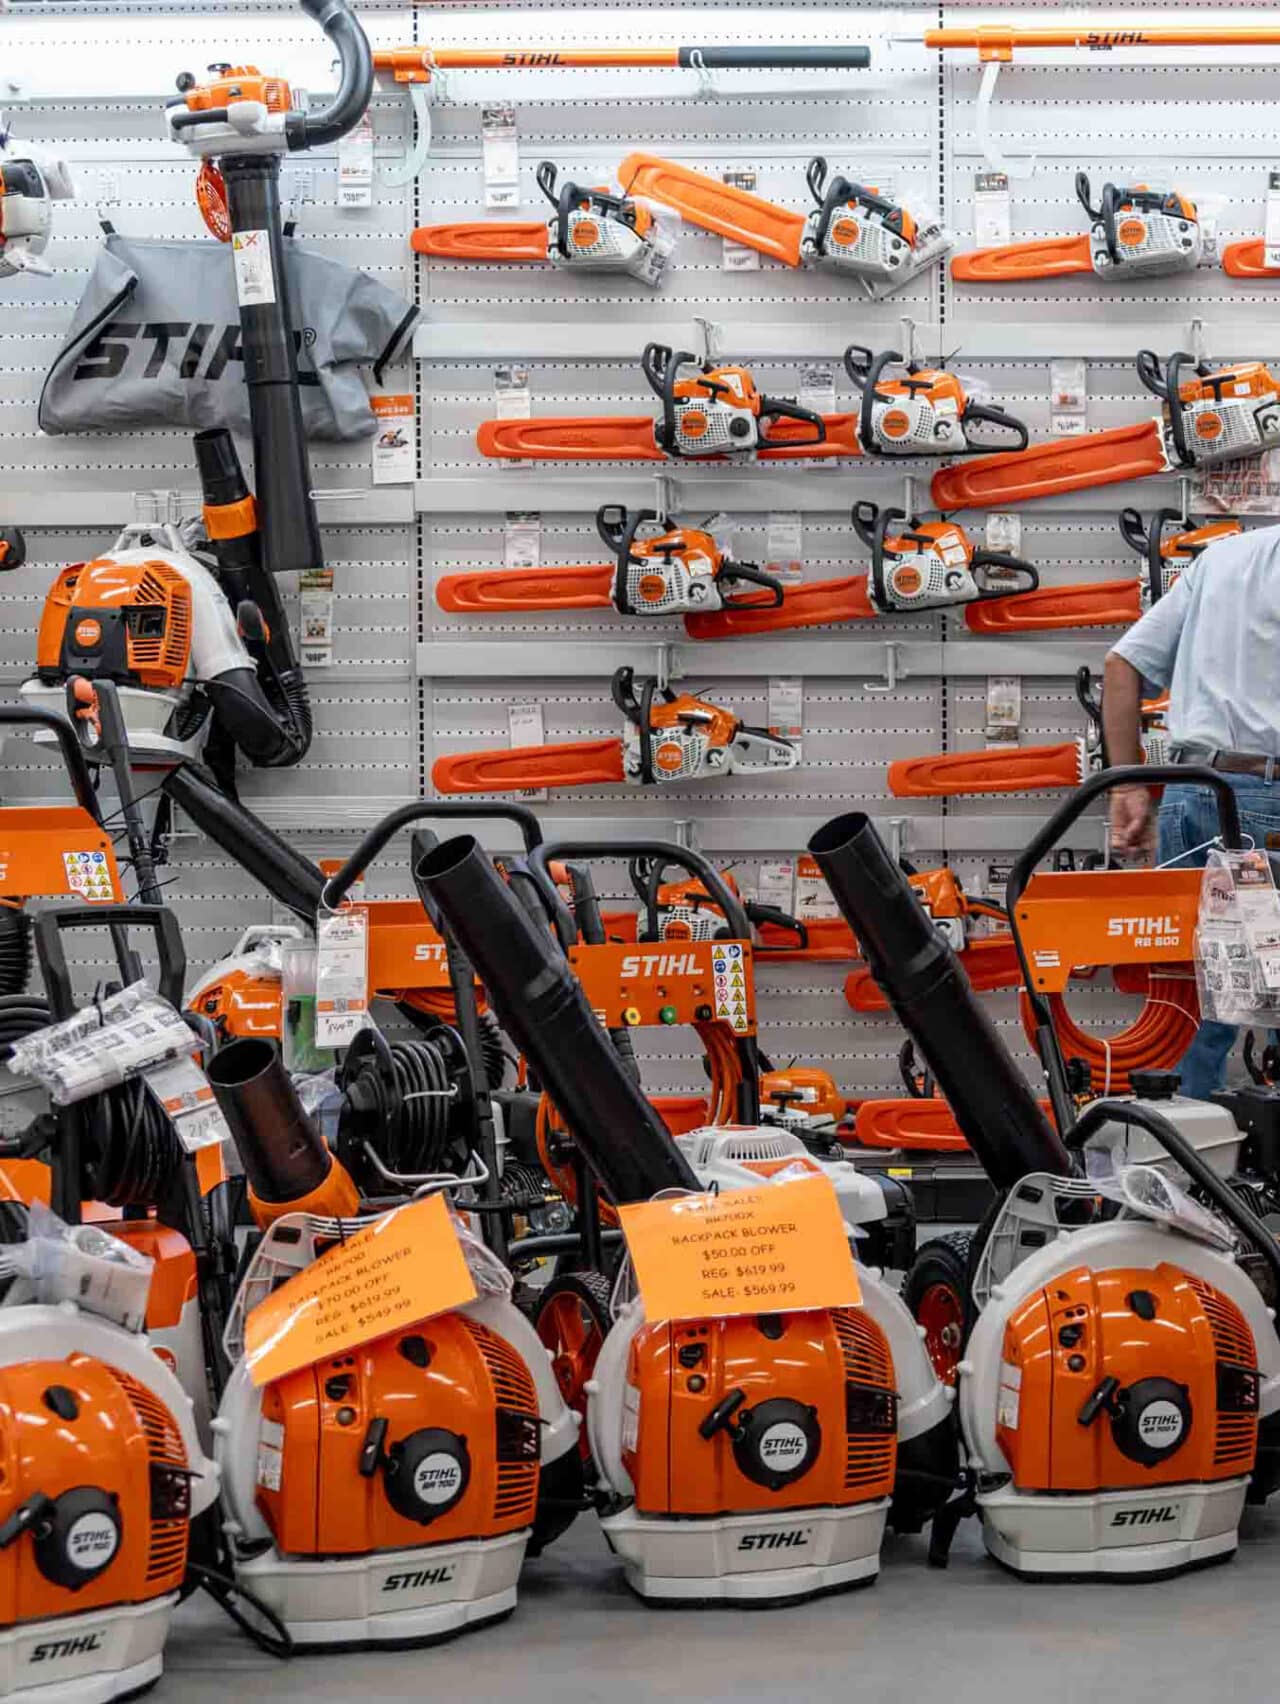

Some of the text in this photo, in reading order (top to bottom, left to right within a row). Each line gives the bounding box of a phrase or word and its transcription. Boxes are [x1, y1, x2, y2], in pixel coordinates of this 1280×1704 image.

[502, 52, 566, 66] STIHL
[1107, 916, 1180, 936] STIHL
[620, 953, 704, 978] STIHL
[671, 1223, 798, 1246] BACKPACK BLOWER
[356, 1246, 412, 1277] BLOWER
[702, 1244, 776, 1261] $50.00 OFF
[736, 1262, 786, 1278] $619.99
[364, 1272, 389, 1289] OFF
[744, 1282, 796, 1297] $569.99
[358, 1299, 412, 1328] $549.99
[1141, 1415, 1179, 1426] STIHL
[763, 1437, 803, 1449] STIHL
[419, 1468, 457, 1481] STIHL
[1110, 1506, 1176, 1527] STIHL
[73, 1530, 113, 1545] STIHL
[737, 1530, 808, 1551] STIHL
[382, 1567, 453, 1591] STIHL
[29, 1633, 101, 1663] STIHL
